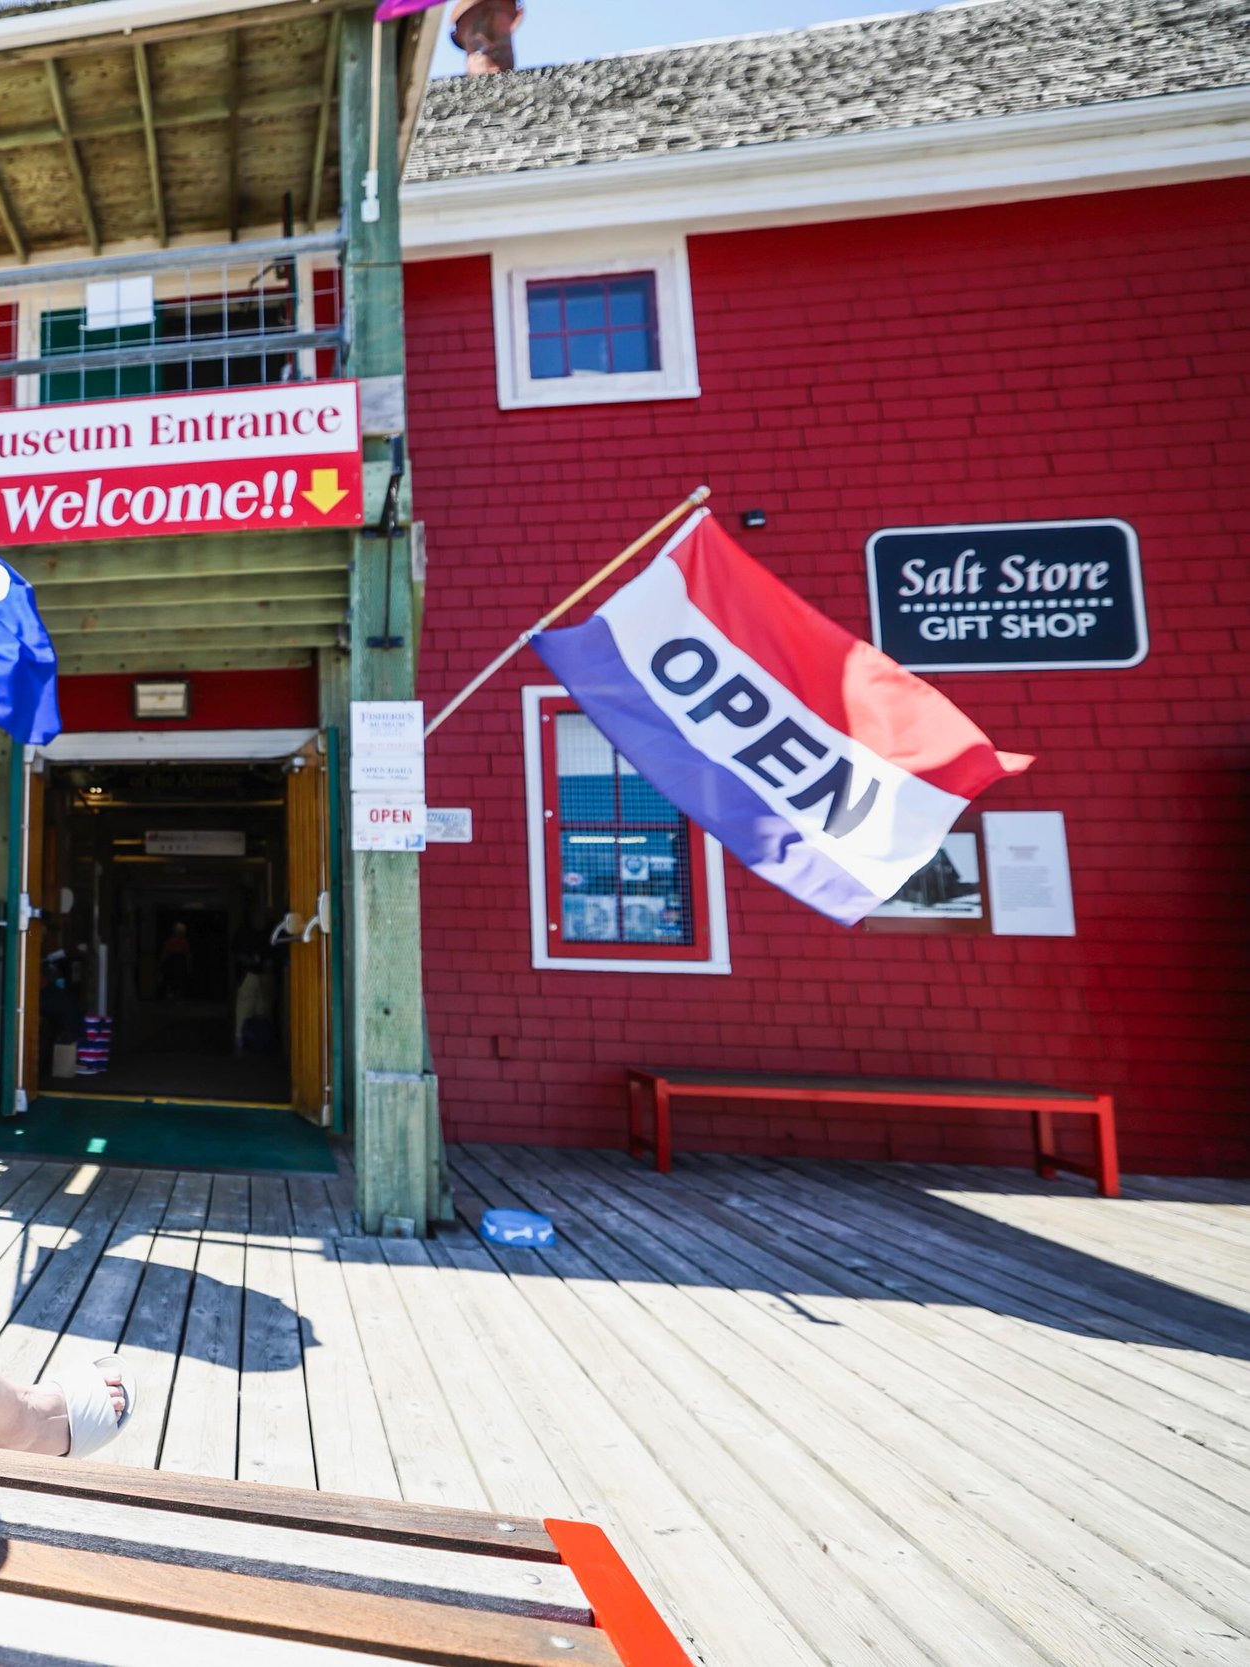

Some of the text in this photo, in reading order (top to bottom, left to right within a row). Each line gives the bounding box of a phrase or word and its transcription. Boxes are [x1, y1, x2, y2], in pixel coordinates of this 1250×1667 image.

[150, 405, 342, 446] Entrance
[0, 469, 298, 534] Welcome!!
[899, 549, 1110, 597] Salt Store
[919, 612, 1097, 641] GIFT SHOP
[650, 637, 881, 838] OPEN
[369, 808, 412, 823] OPEN
